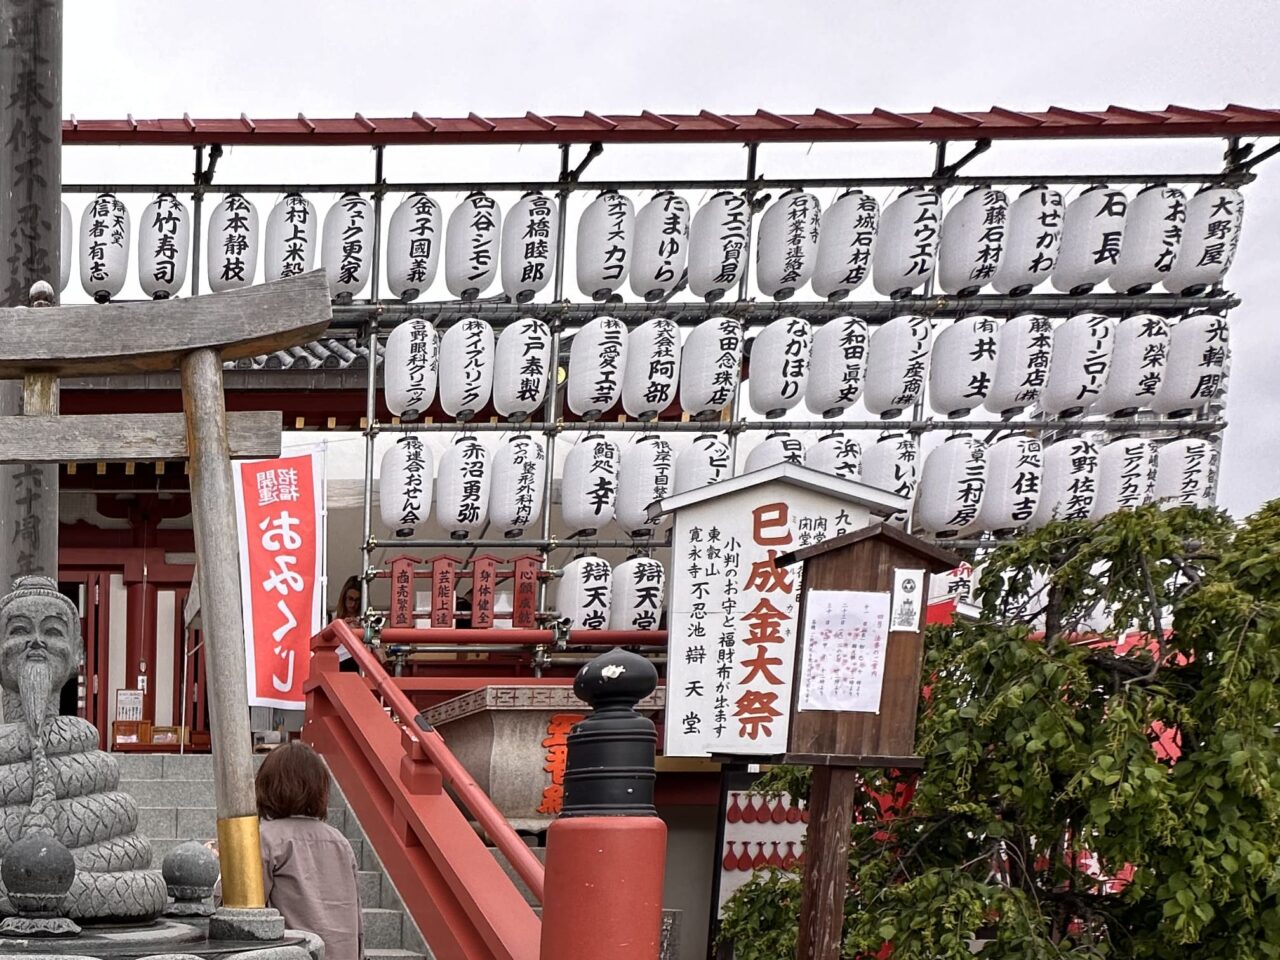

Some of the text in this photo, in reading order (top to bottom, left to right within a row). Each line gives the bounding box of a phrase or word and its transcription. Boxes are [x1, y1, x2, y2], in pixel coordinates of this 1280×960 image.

[88, 199, 110, 282] 信者有志
[152, 211, 180, 284] 竹寿司
[221, 198, 252, 282] 松本静枝
[337, 197, 366, 284] デューク更家
[406, 197, 436, 282] 金子國義
[467, 197, 496, 281] 四谷シモン
[521, 196, 551, 283] 高橋睦郎
[654, 195, 685, 282] たまゆら
[713, 195, 746, 283] ウエニ貿易
[780, 196, 809, 284] 石材業者連絡会
[839, 195, 877, 284] 岩城石材店
[904, 193, 939, 276] コムウエル
[1028, 190, 1063, 273] はせがわ
[1092, 192, 1127, 266] 石長
[1197, 196, 1233, 267] 大野屋
[406, 320, 429, 407] 吉野眼科クリニック
[516, 320, 548, 402] 水戸奉製
[705, 319, 741, 405] 安田念珠店
[781, 319, 808, 400] なかほり
[1136, 318, 1169, 397] 松榮堂
[1190, 319, 1229, 400] 光輪閣
[399, 440, 426, 525] 桜連合おせん会
[456, 443, 486, 524] 赤沼勇弥
[731, 502, 795, 740] 巳成金大祭
